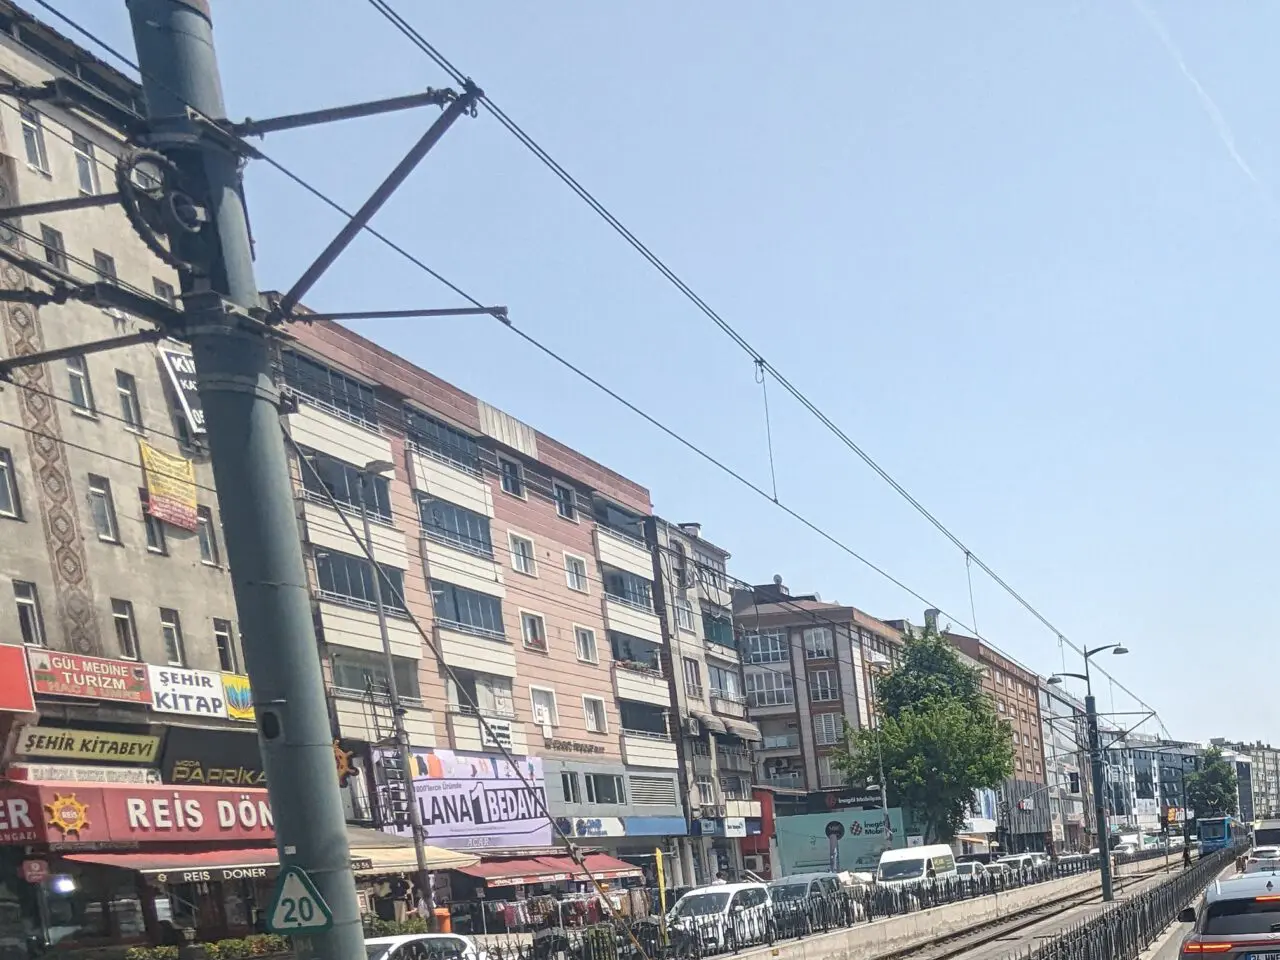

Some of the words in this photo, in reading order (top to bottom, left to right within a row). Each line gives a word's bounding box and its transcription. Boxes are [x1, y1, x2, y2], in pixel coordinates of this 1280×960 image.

[52, 656, 80, 671] GÜL
[82, 661, 129, 677] MEDİNE
[159, 671, 214, 688] ŞEHİR
[154, 689, 224, 714] KİTAP
[25, 732, 75, 753] ŞEHİR
[79, 735, 154, 757] KİTABEVİ
[172, 766, 268, 785] PAPRİKA
[127, 793, 204, 828] REİS
[217, 795, 274, 827] DÖN
[488, 789, 547, 821] BEDAVA
[281, 896, 314, 923] 20
